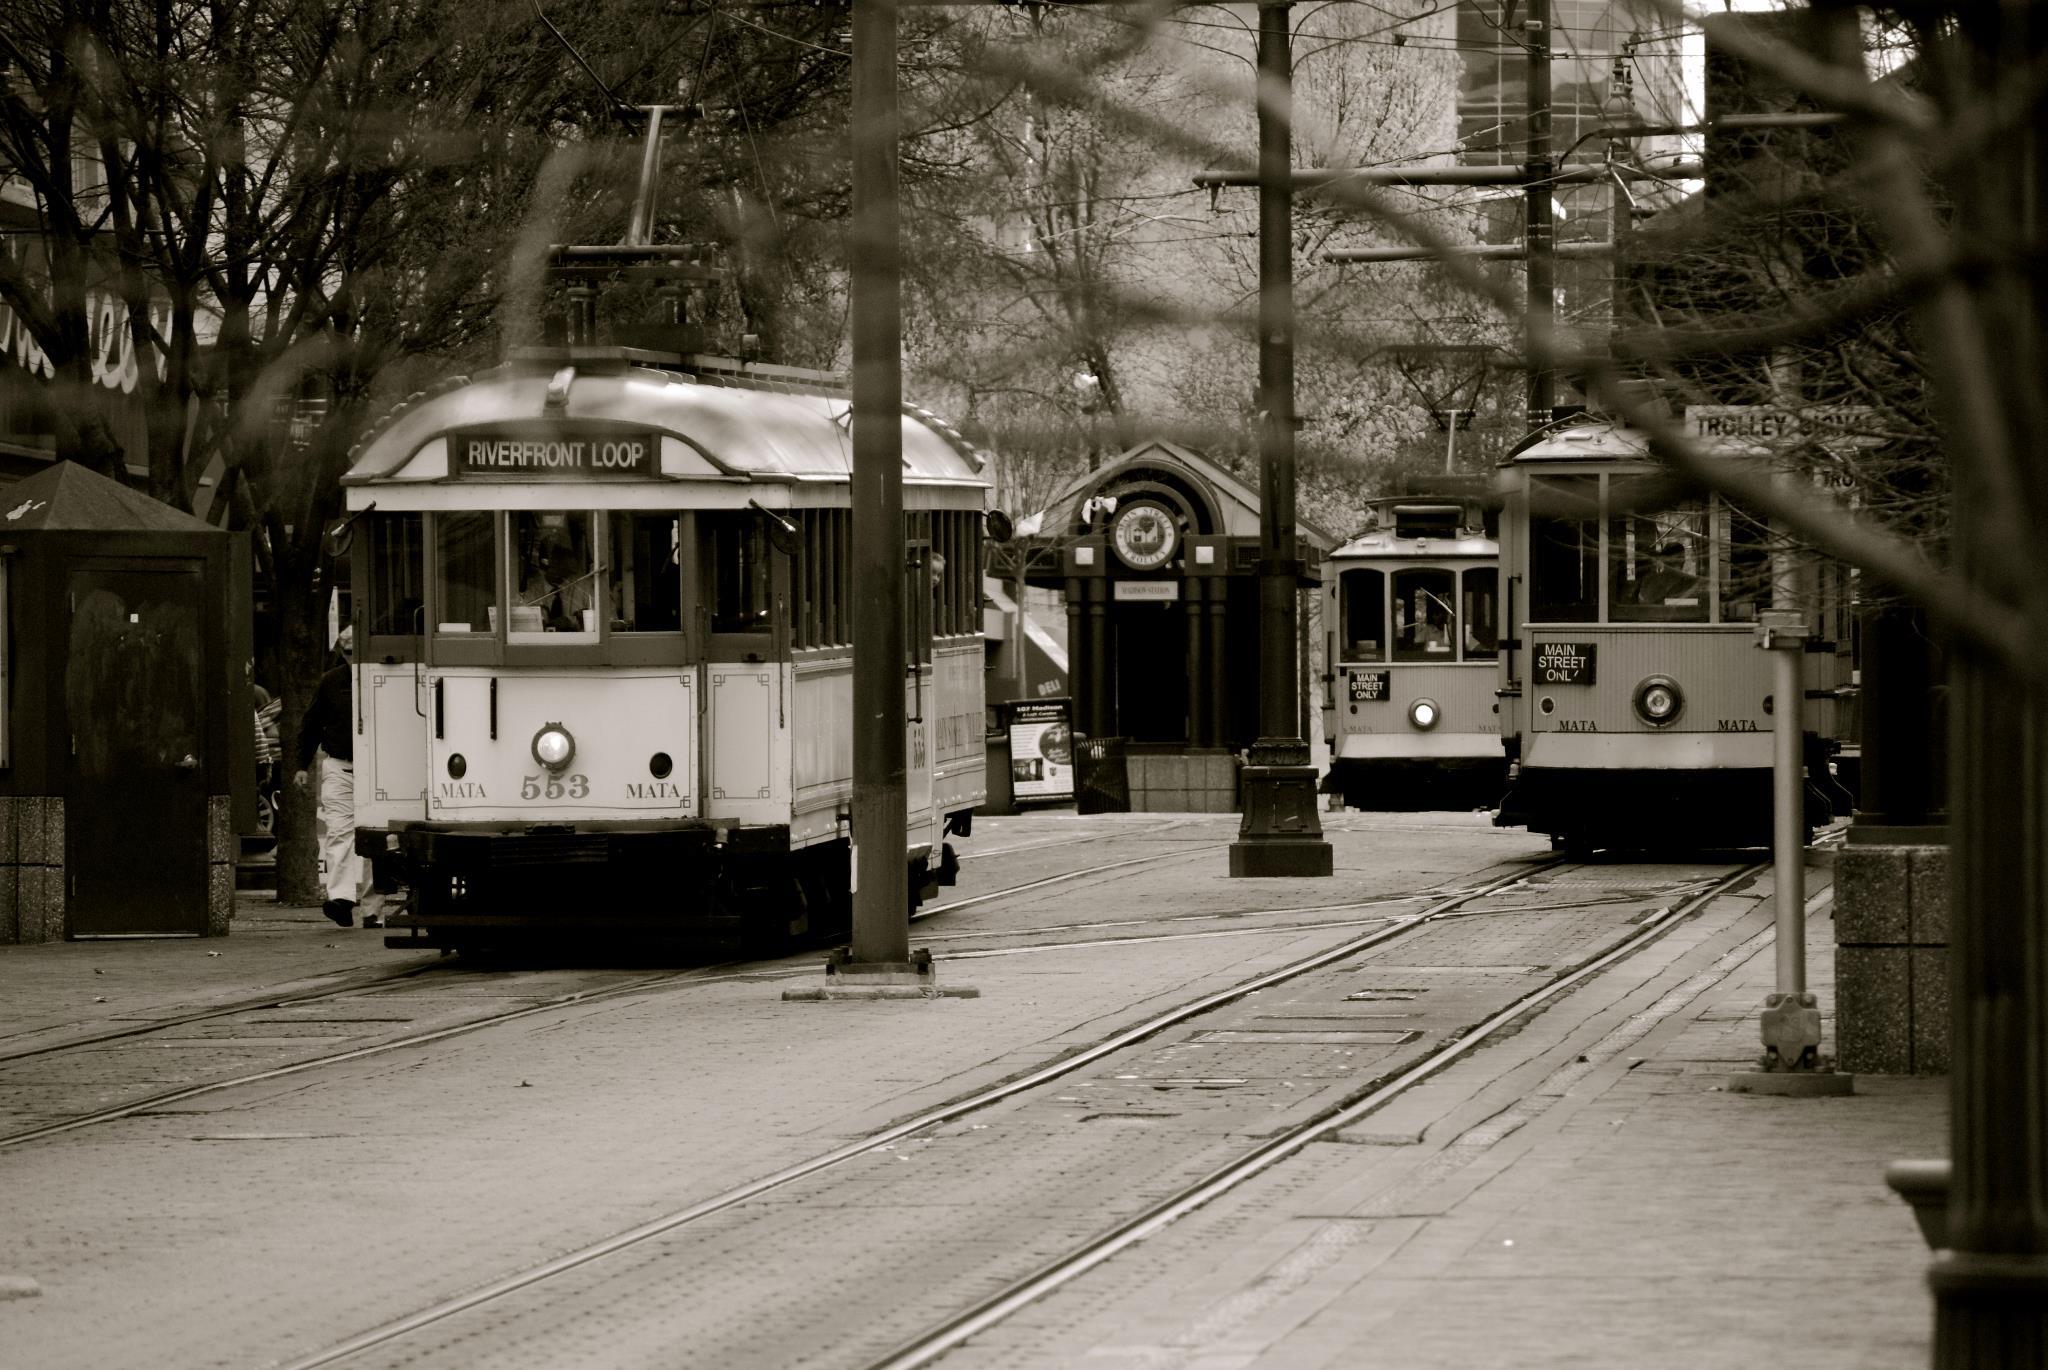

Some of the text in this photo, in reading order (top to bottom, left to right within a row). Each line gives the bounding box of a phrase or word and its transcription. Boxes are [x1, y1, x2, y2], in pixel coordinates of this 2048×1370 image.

[1696, 415, 1788, 437] TROLLEY
[468, 440, 644, 468] RIVERFRONT LOOP
[1545, 643, 1576, 656] MAIN
[1538, 656, 1587, 669] STREET
[1356, 673, 1379, 682] MAIN
[1038, 679, 1061, 696] DELI
[1351, 681, 1384, 691] STREET
[1355, 690, 1379, 699] ONLY
[1559, 720, 1598, 731] MATA
[1718, 719, 1757, 731] MATA
[441, 782, 488, 799] MATA
[520, 773, 590, 800] 553
[626, 782, 681, 799] MATA
